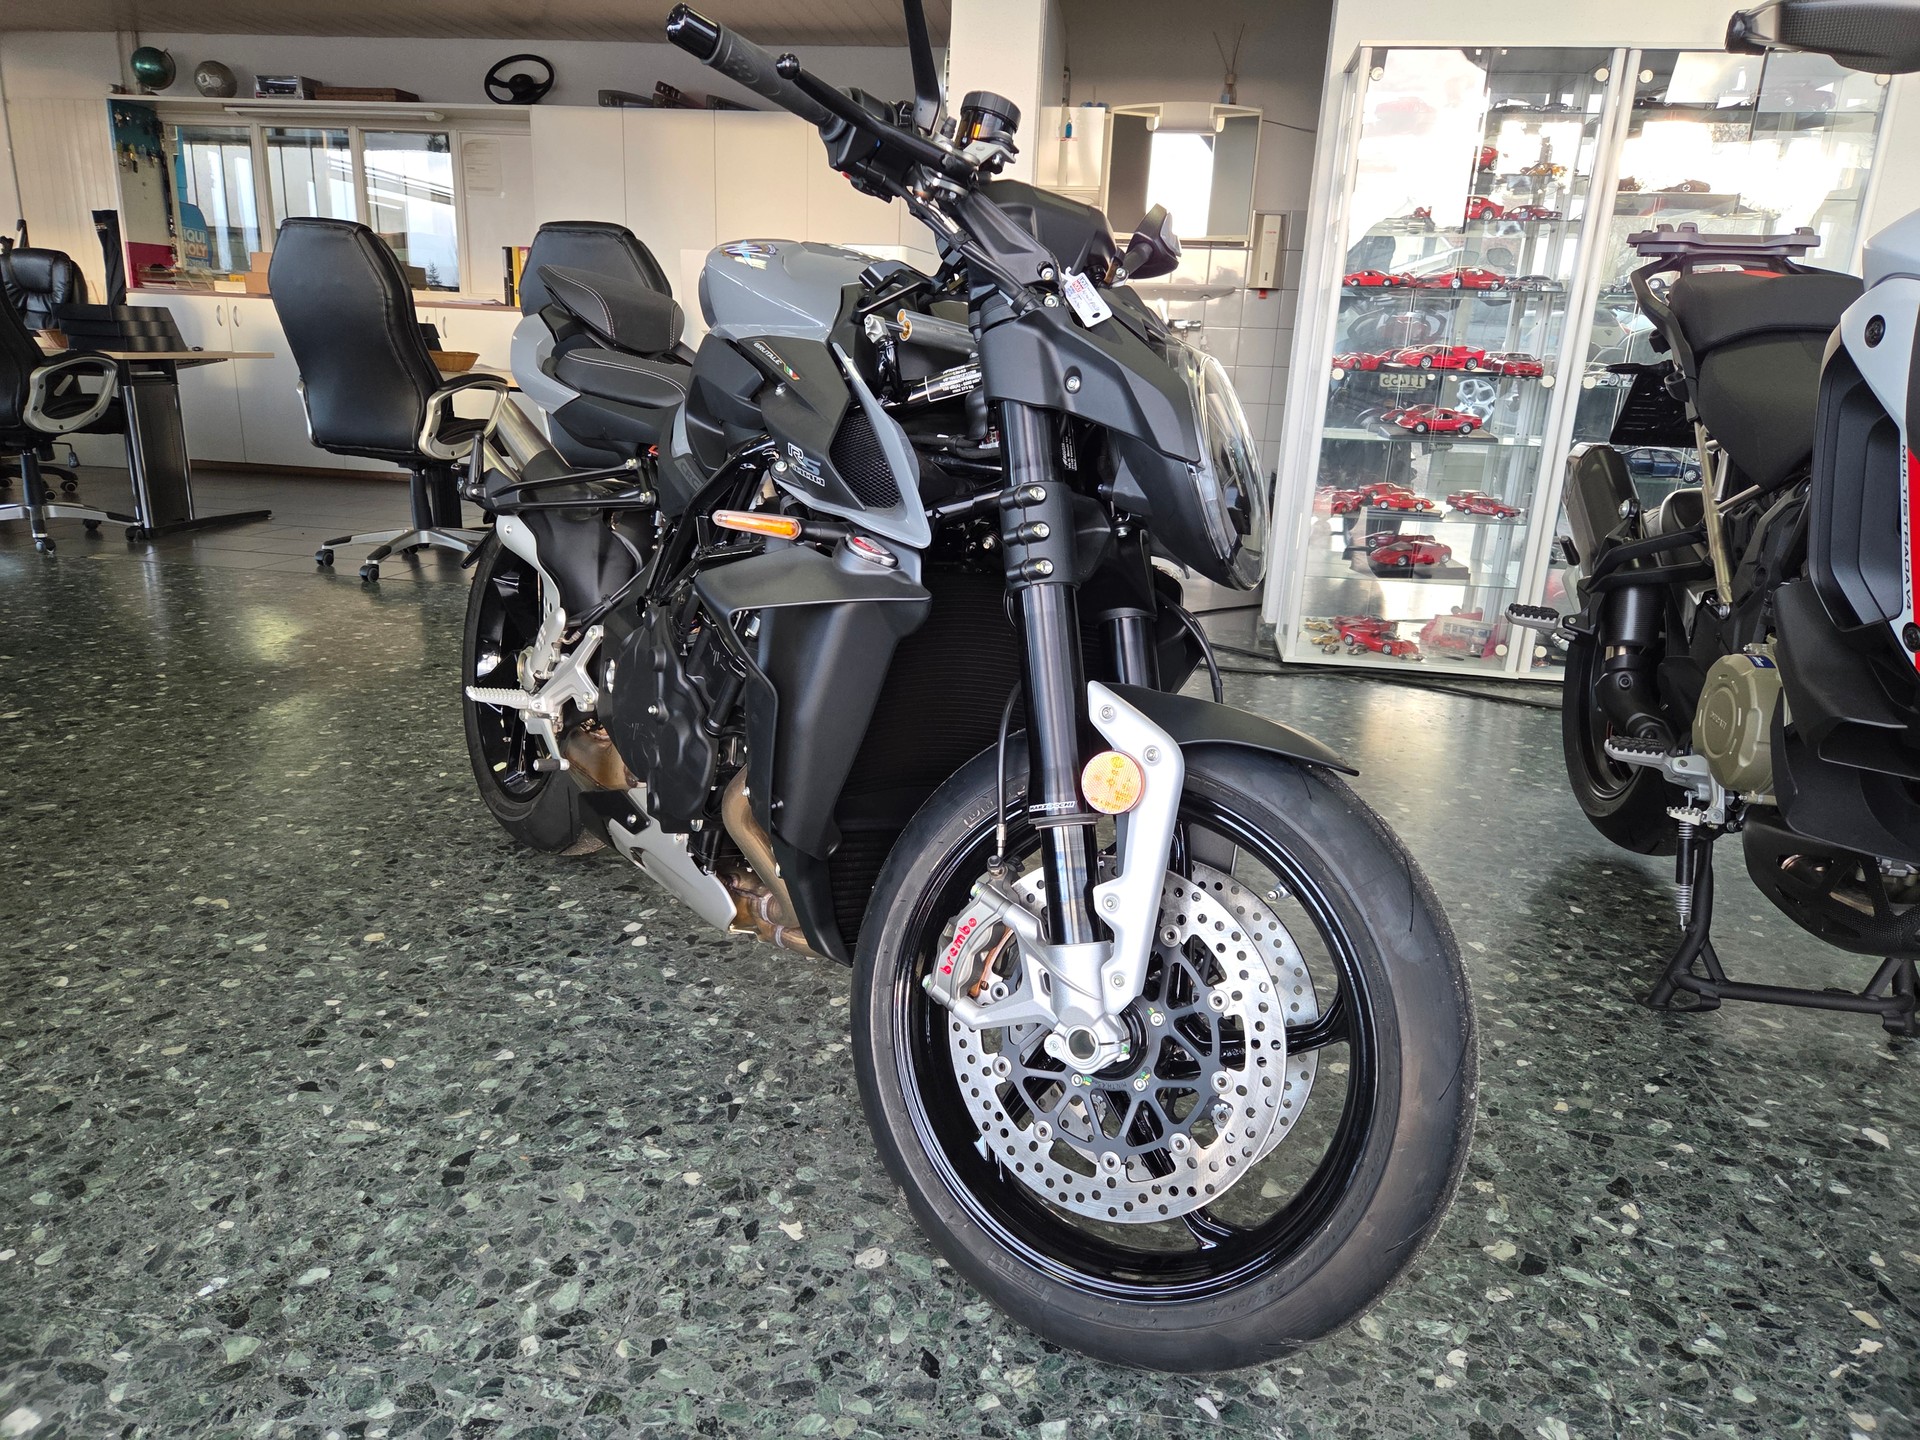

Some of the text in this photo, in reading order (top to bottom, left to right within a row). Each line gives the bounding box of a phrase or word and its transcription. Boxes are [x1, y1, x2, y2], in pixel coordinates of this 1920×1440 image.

[183, 229, 206, 243] IQUI
[186, 243, 208, 258] OLY
[787, 441, 821, 476] RS
[1902, 444, 1912, 611] MULTISTRADA V4
[1029, 801, 1076, 812] MARZOCCHI
[940, 917, 978, 975] brembo
